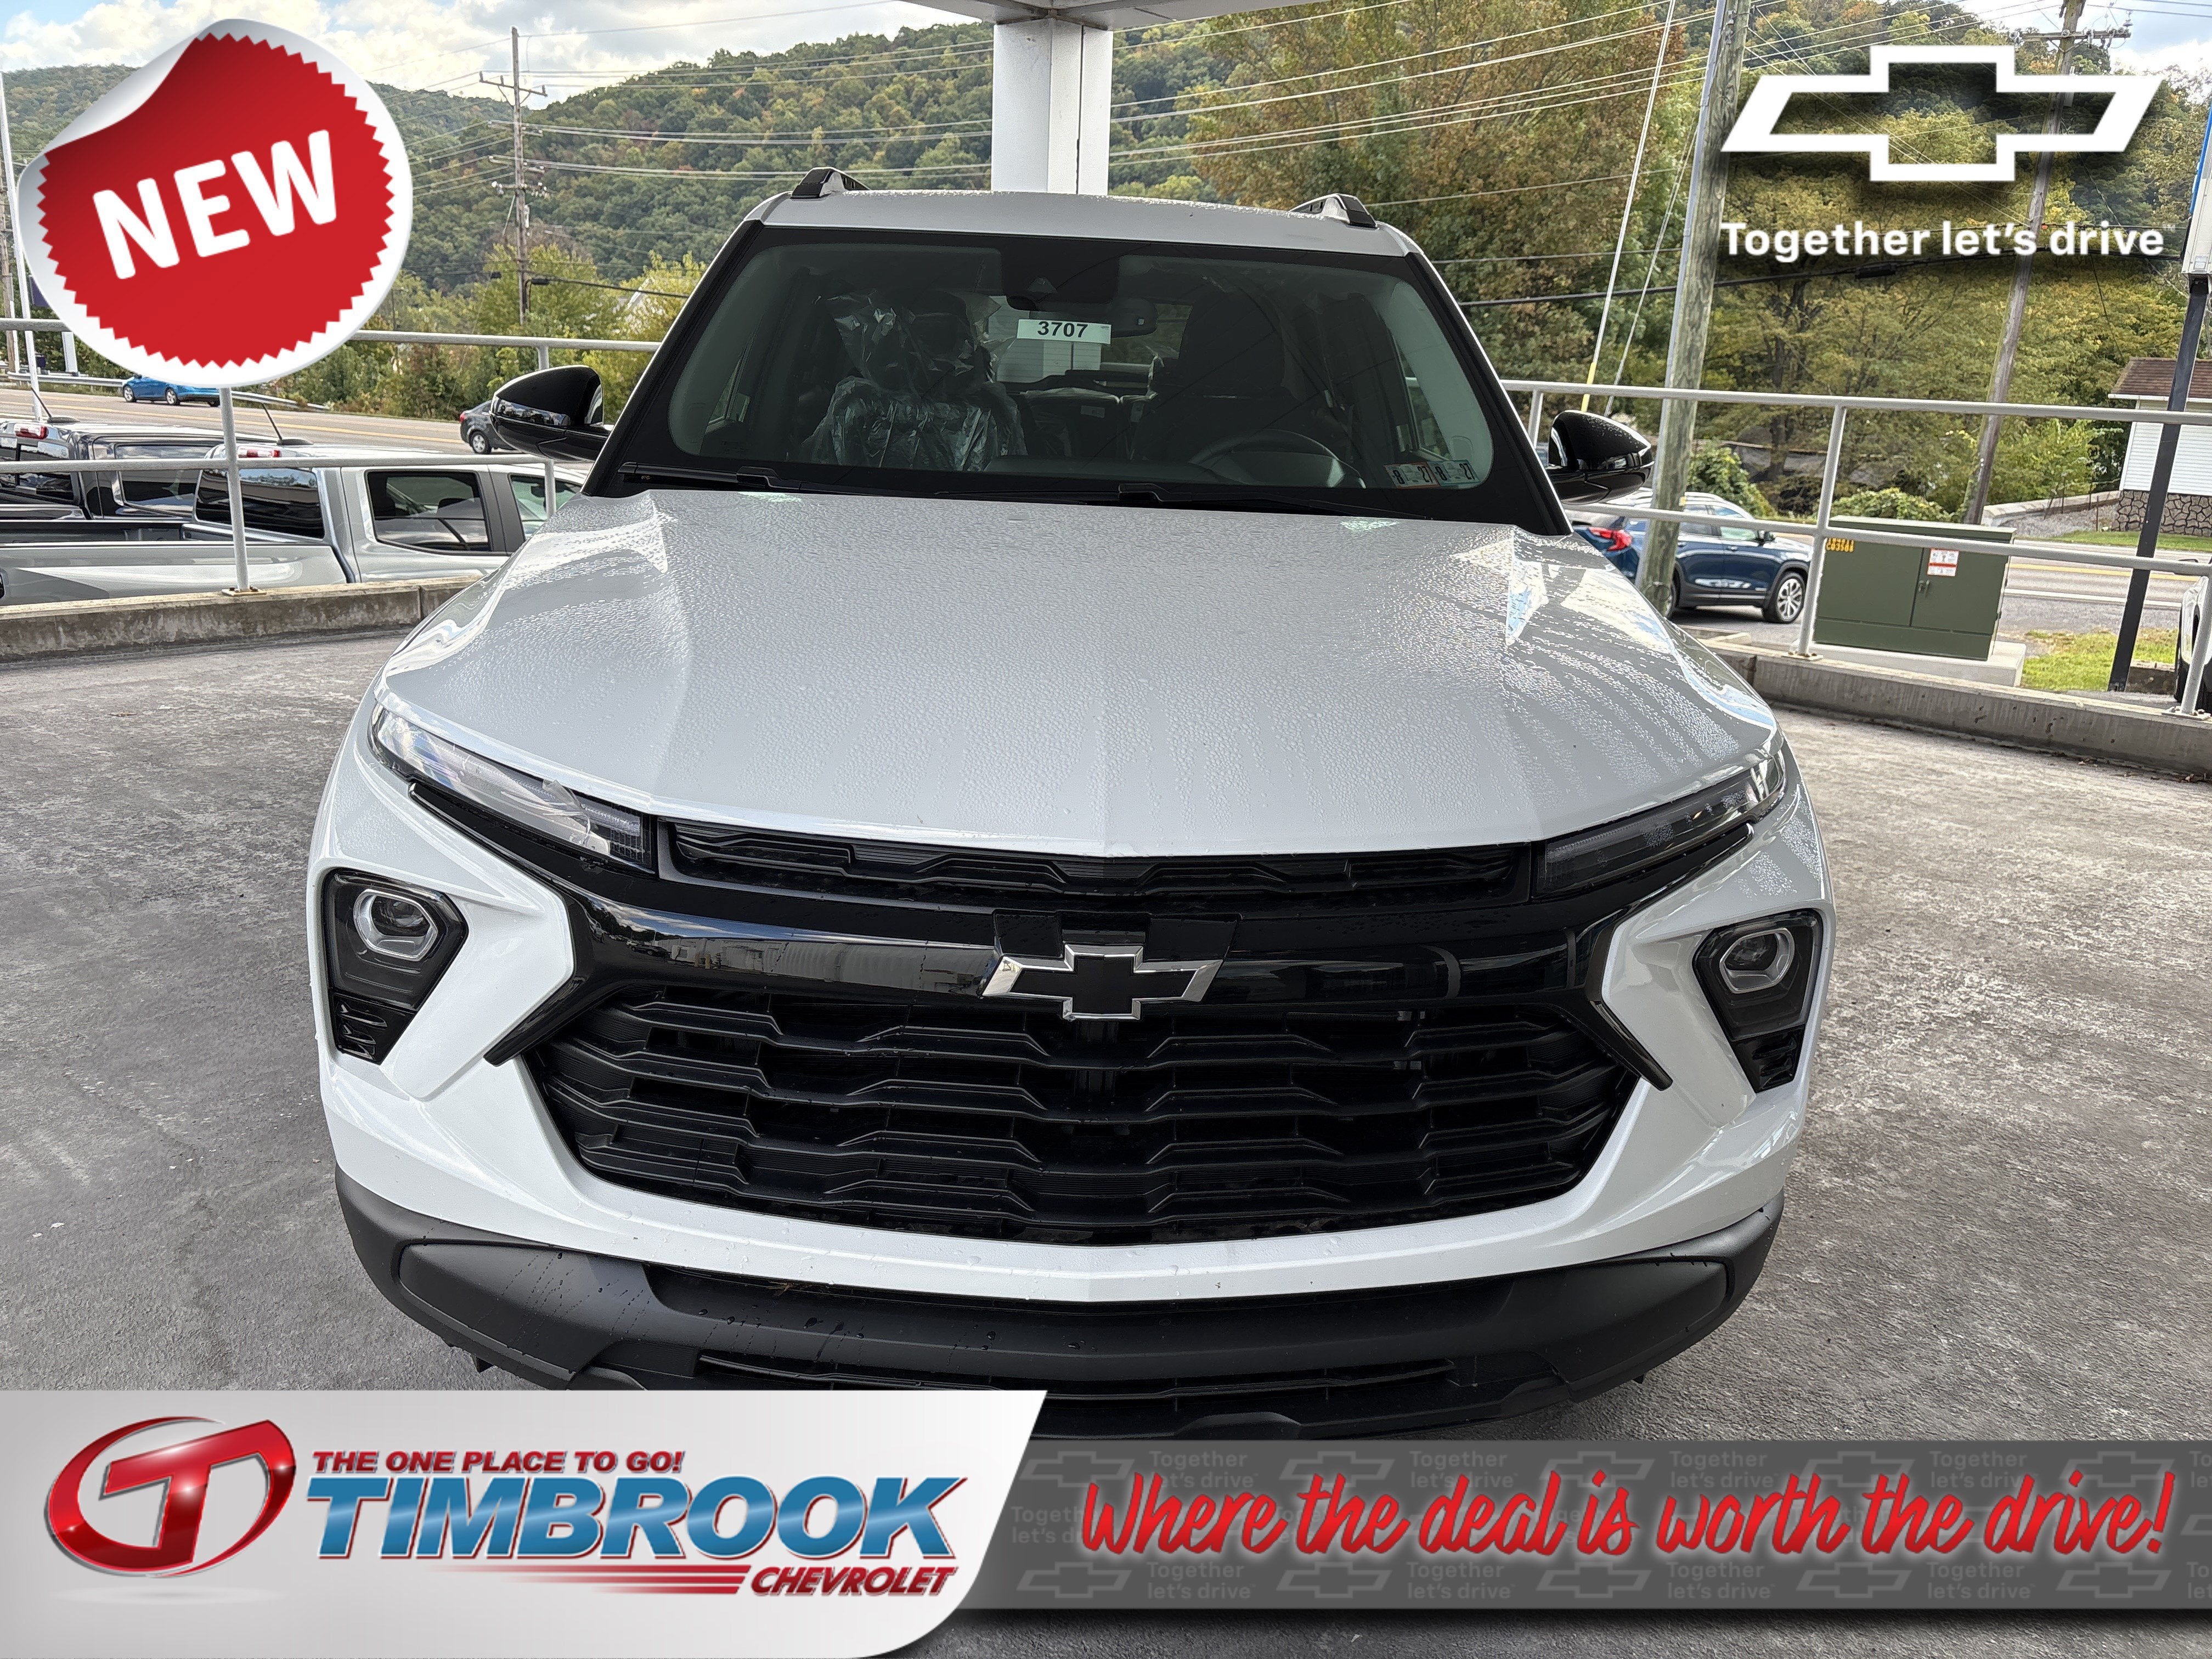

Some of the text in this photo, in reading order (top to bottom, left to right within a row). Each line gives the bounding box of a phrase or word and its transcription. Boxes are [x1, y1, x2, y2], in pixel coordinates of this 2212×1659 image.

[1037, 320, 1088, 338] 3707
[1417, 465, 1434, 484] 27
[1459, 462, 1475, 481] 27
